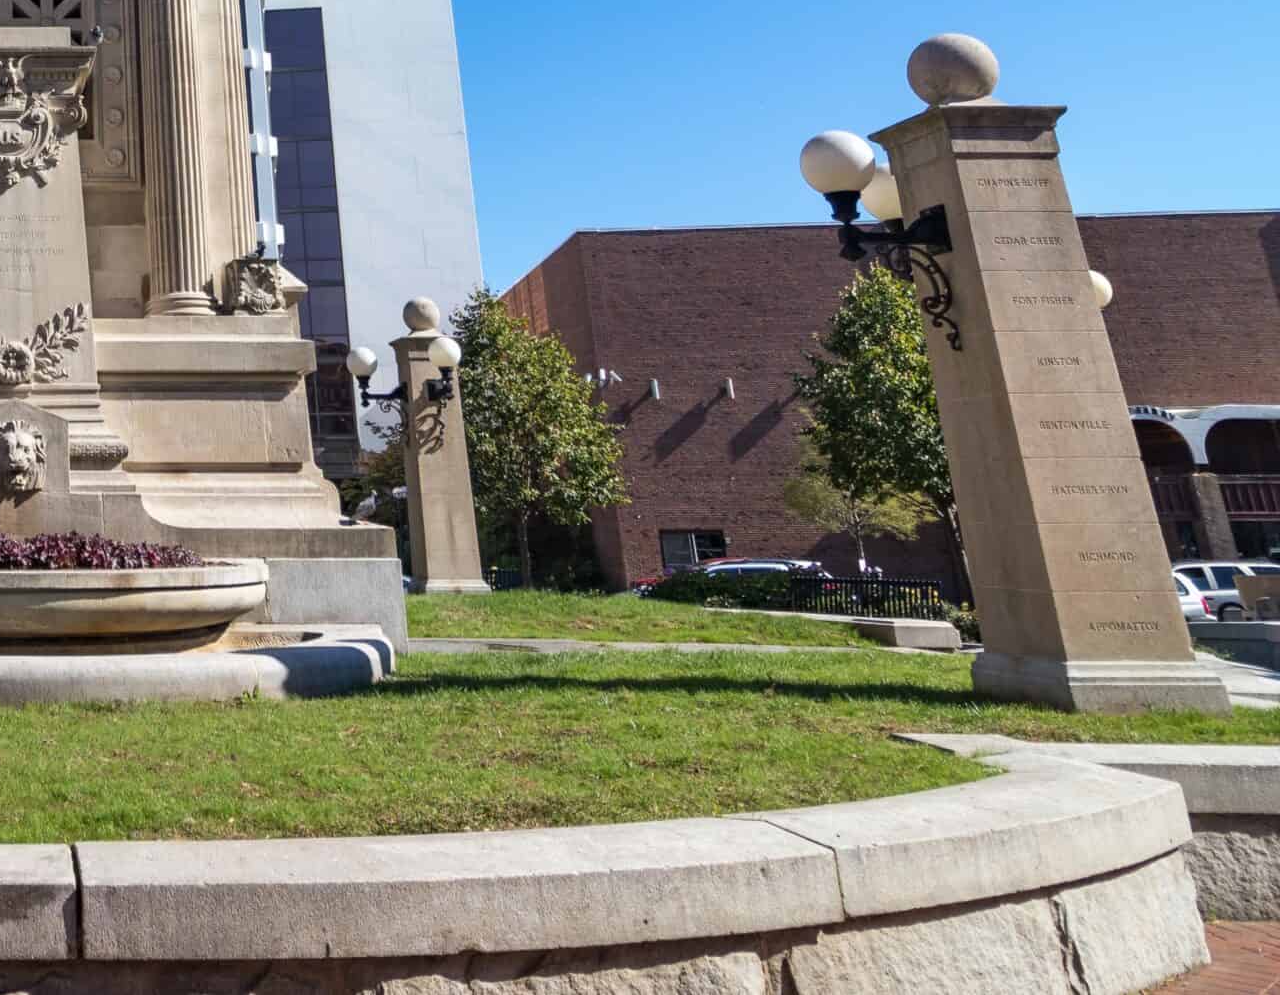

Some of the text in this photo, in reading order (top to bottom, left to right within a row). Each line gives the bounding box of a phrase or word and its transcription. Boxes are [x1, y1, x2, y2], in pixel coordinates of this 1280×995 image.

[993, 236, 1061, 246] CEDAR CREEK
[1011, 295, 1074, 306] FORT FISHER
[1036, 356, 1080, 366] KINSTON
[1039, 420, 1109, 430] BENTONVILLE
[1079, 551, 1134, 562] RICHMOND
[1088, 621, 1160, 632] APPOMATTOX
